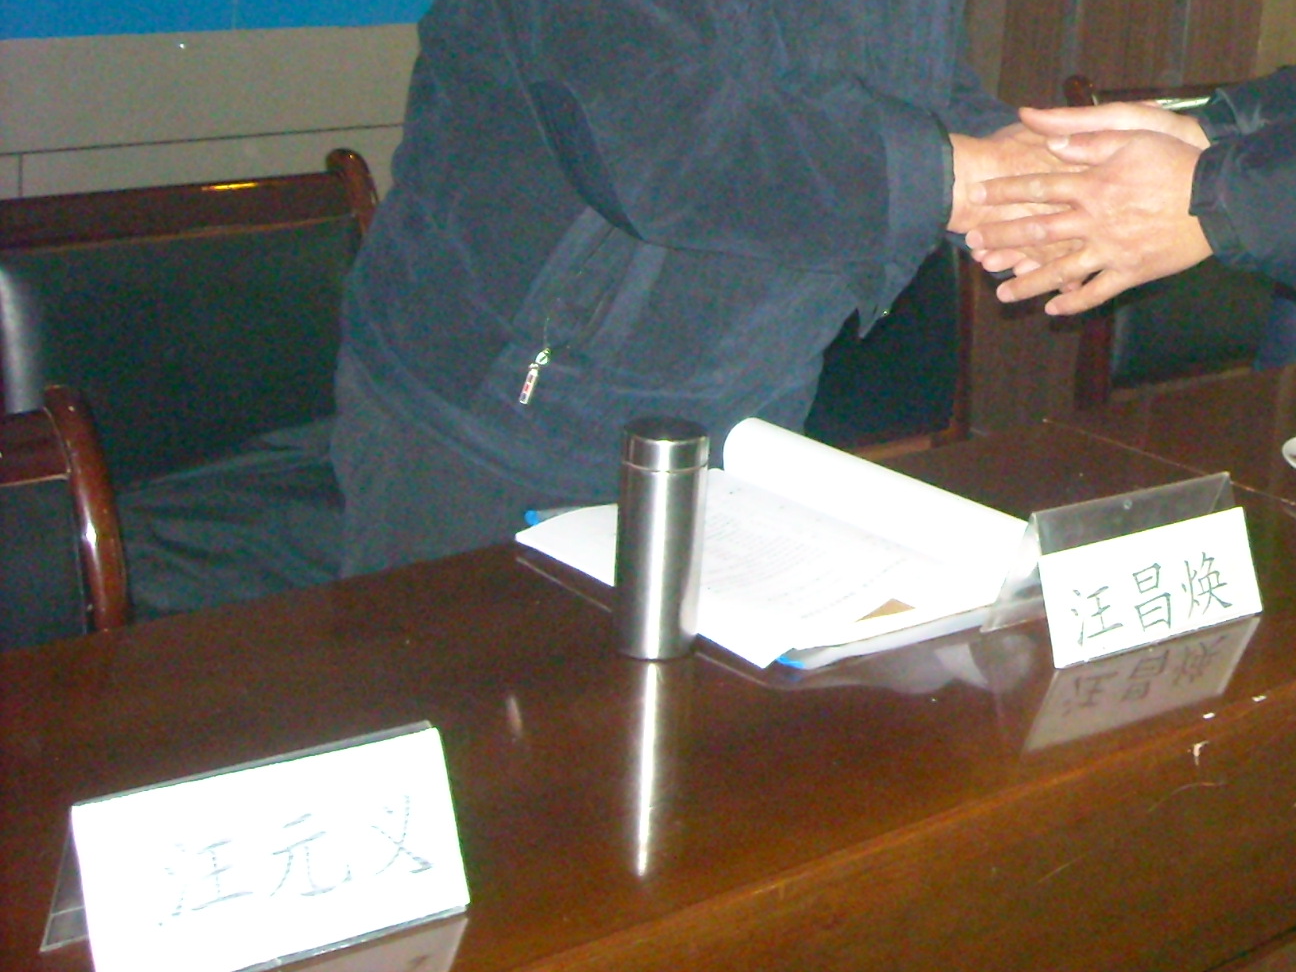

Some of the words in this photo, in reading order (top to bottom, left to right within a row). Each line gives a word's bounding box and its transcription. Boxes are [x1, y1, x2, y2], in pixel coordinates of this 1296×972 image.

[1071, 551, 1234, 647] 汪昌焕
[156, 794, 433, 927] 汪元义
